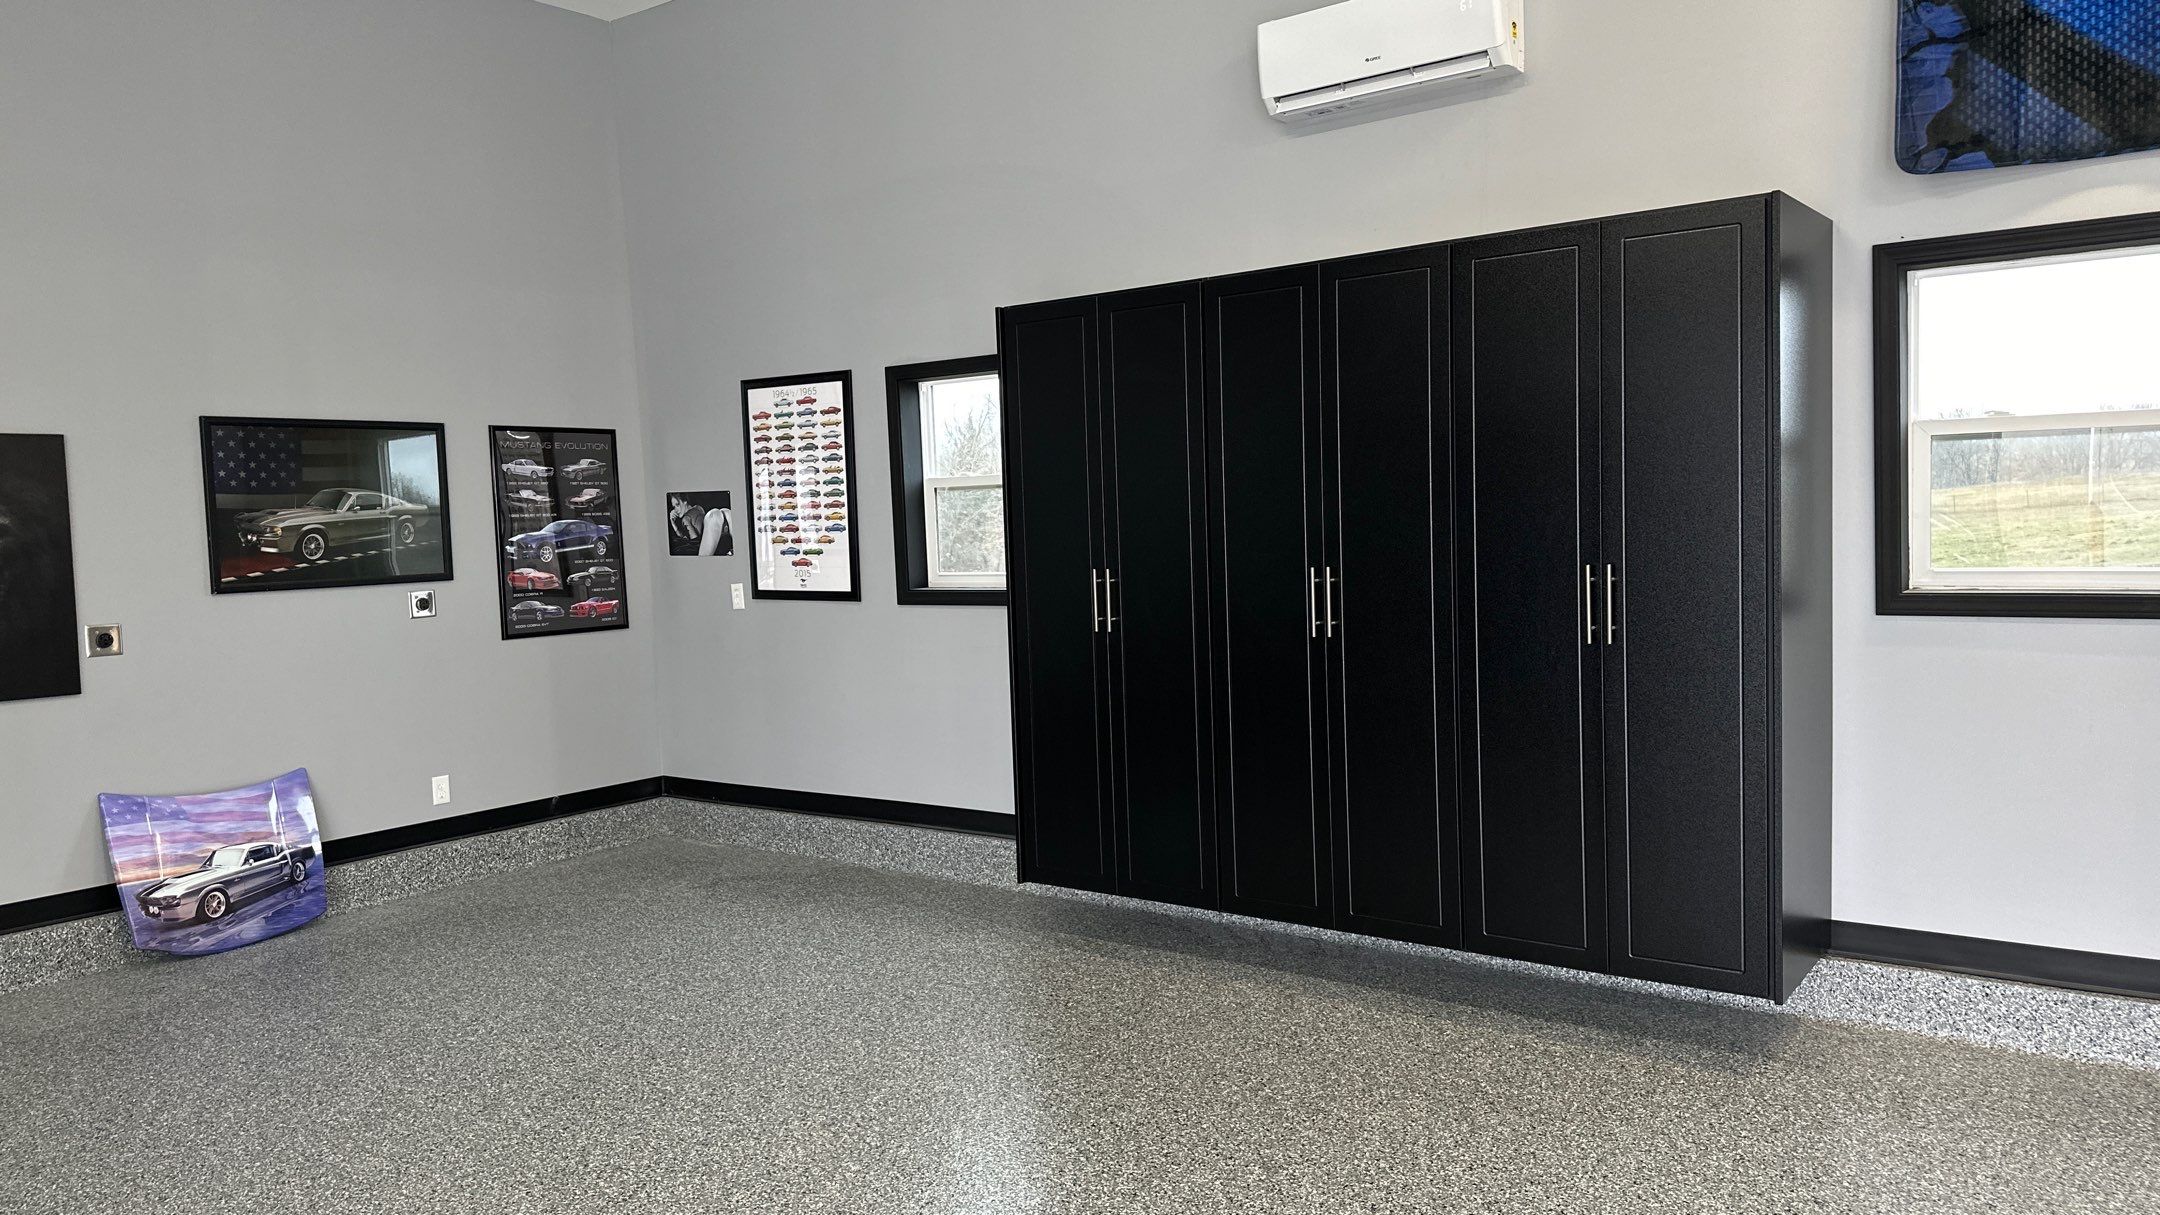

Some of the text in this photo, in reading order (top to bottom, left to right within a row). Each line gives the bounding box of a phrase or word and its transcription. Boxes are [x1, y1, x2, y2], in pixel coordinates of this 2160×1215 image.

[500, 441, 608, 450] MUSTANG EVOLUTION
[794, 569, 811, 578] 2015
